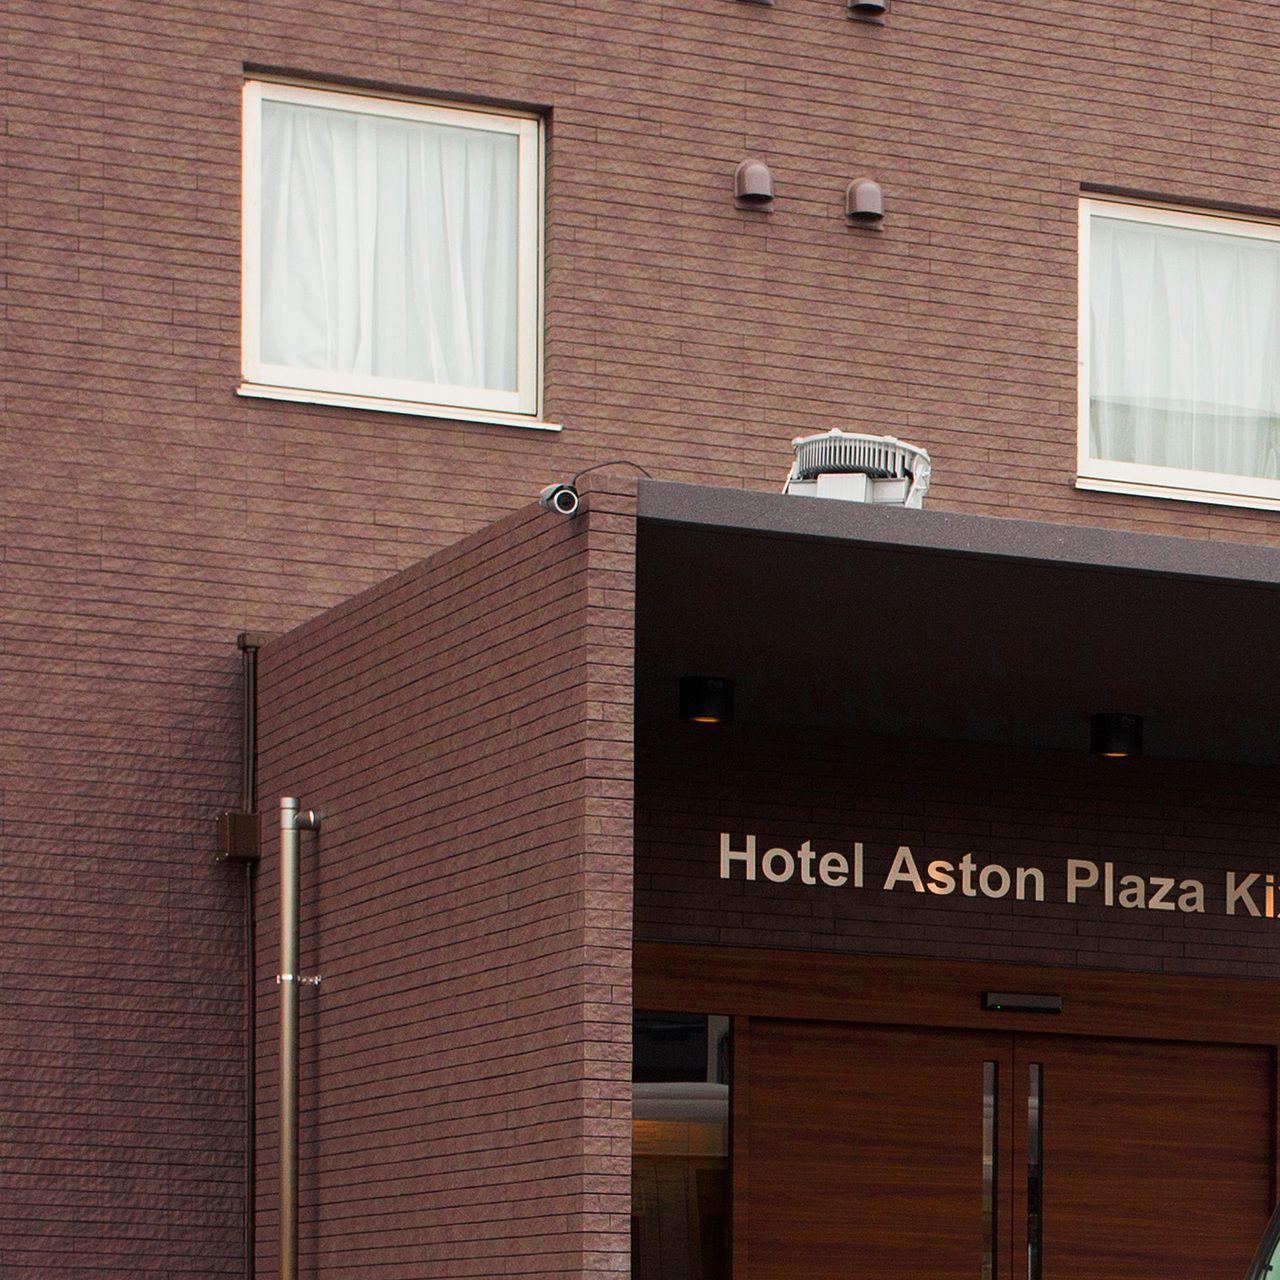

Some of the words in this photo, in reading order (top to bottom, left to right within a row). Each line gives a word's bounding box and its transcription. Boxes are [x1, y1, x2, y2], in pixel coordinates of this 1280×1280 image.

[719, 832, 864, 888] Hotel
[883, 845, 1045, 902] Aston
[1066, 858, 1206, 913] Plaza
